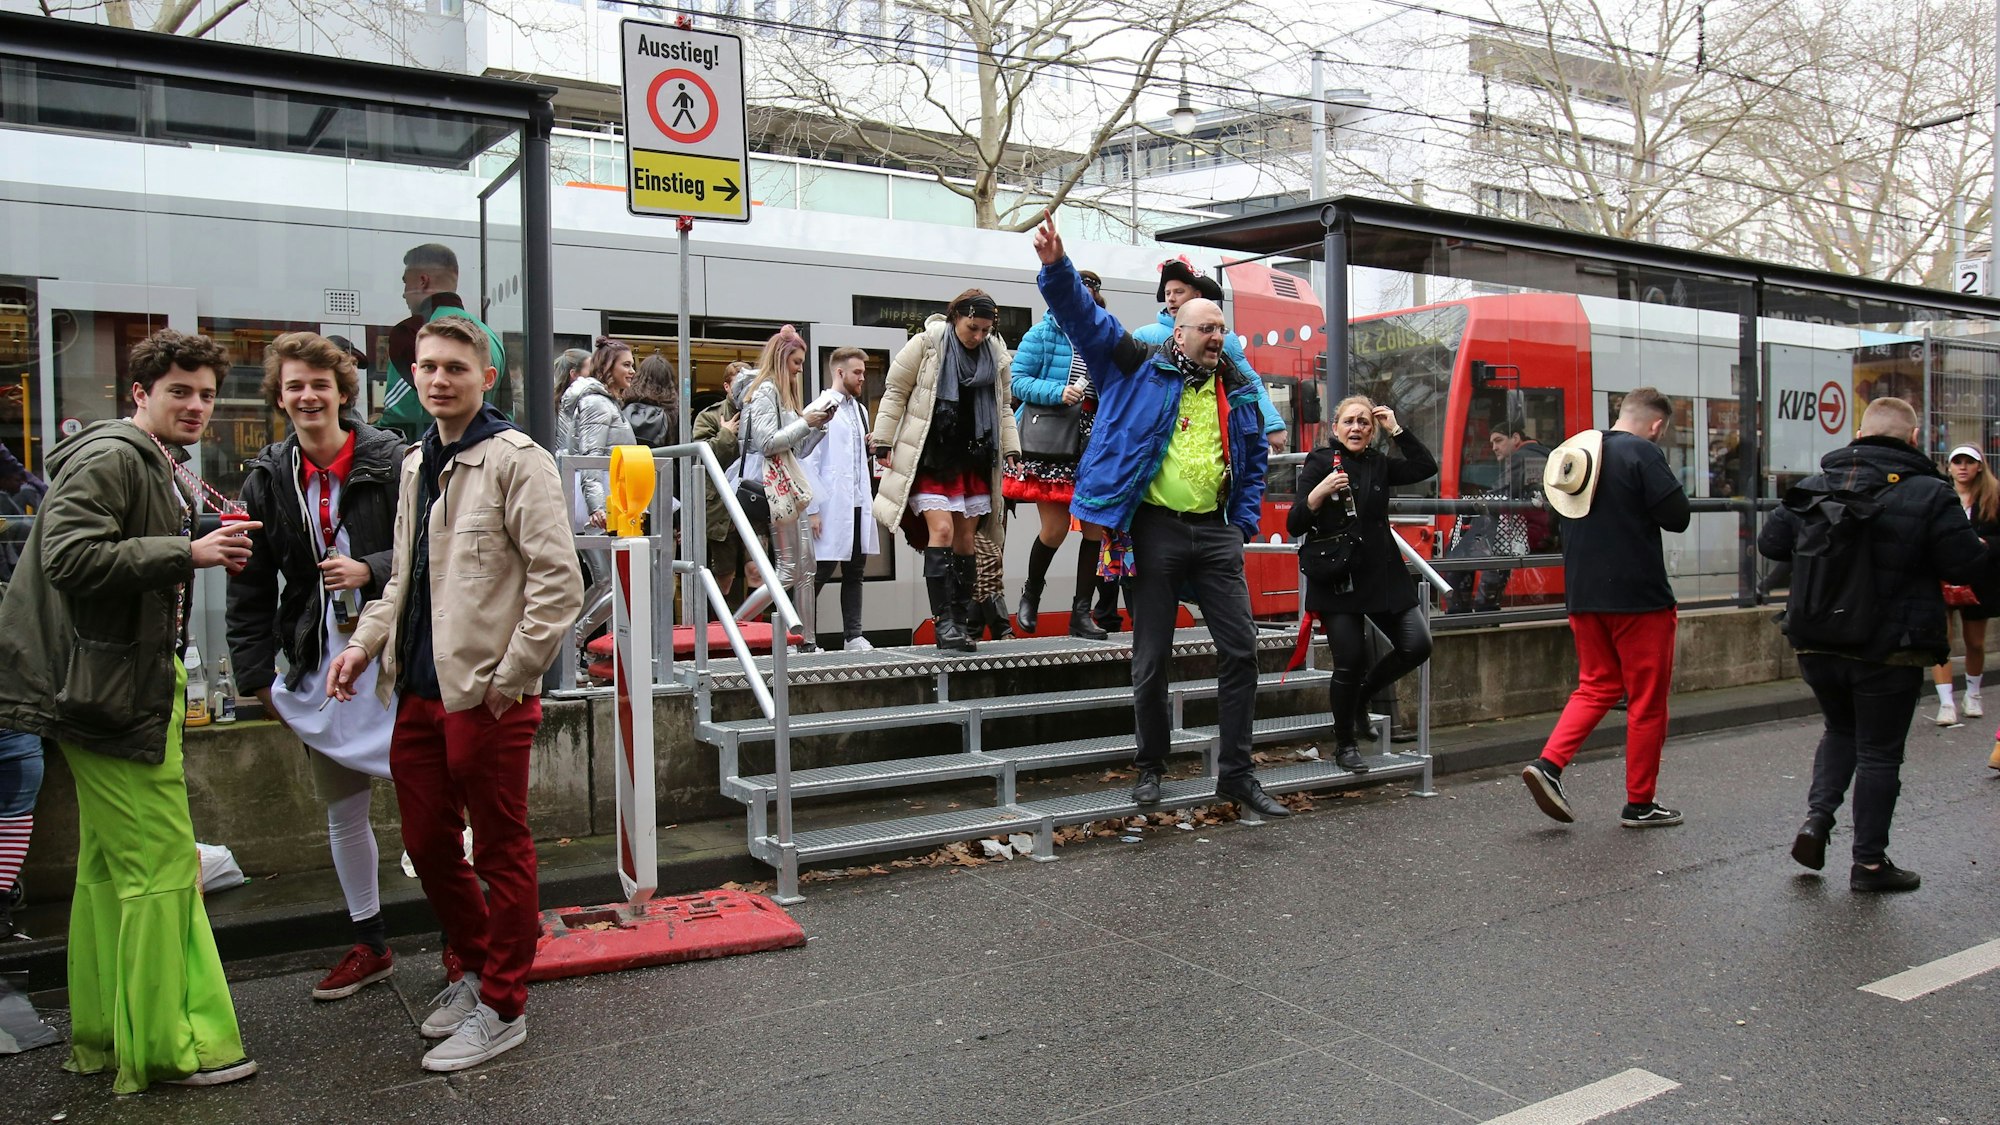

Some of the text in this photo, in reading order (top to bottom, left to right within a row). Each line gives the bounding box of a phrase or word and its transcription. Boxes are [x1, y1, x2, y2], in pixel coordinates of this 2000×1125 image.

[637, 33, 719, 70] Ausstieg!
[634, 167, 705, 201] Einstieg
[1961, 271, 1978, 294] 2
[1778, 389, 1817, 421] KVB
